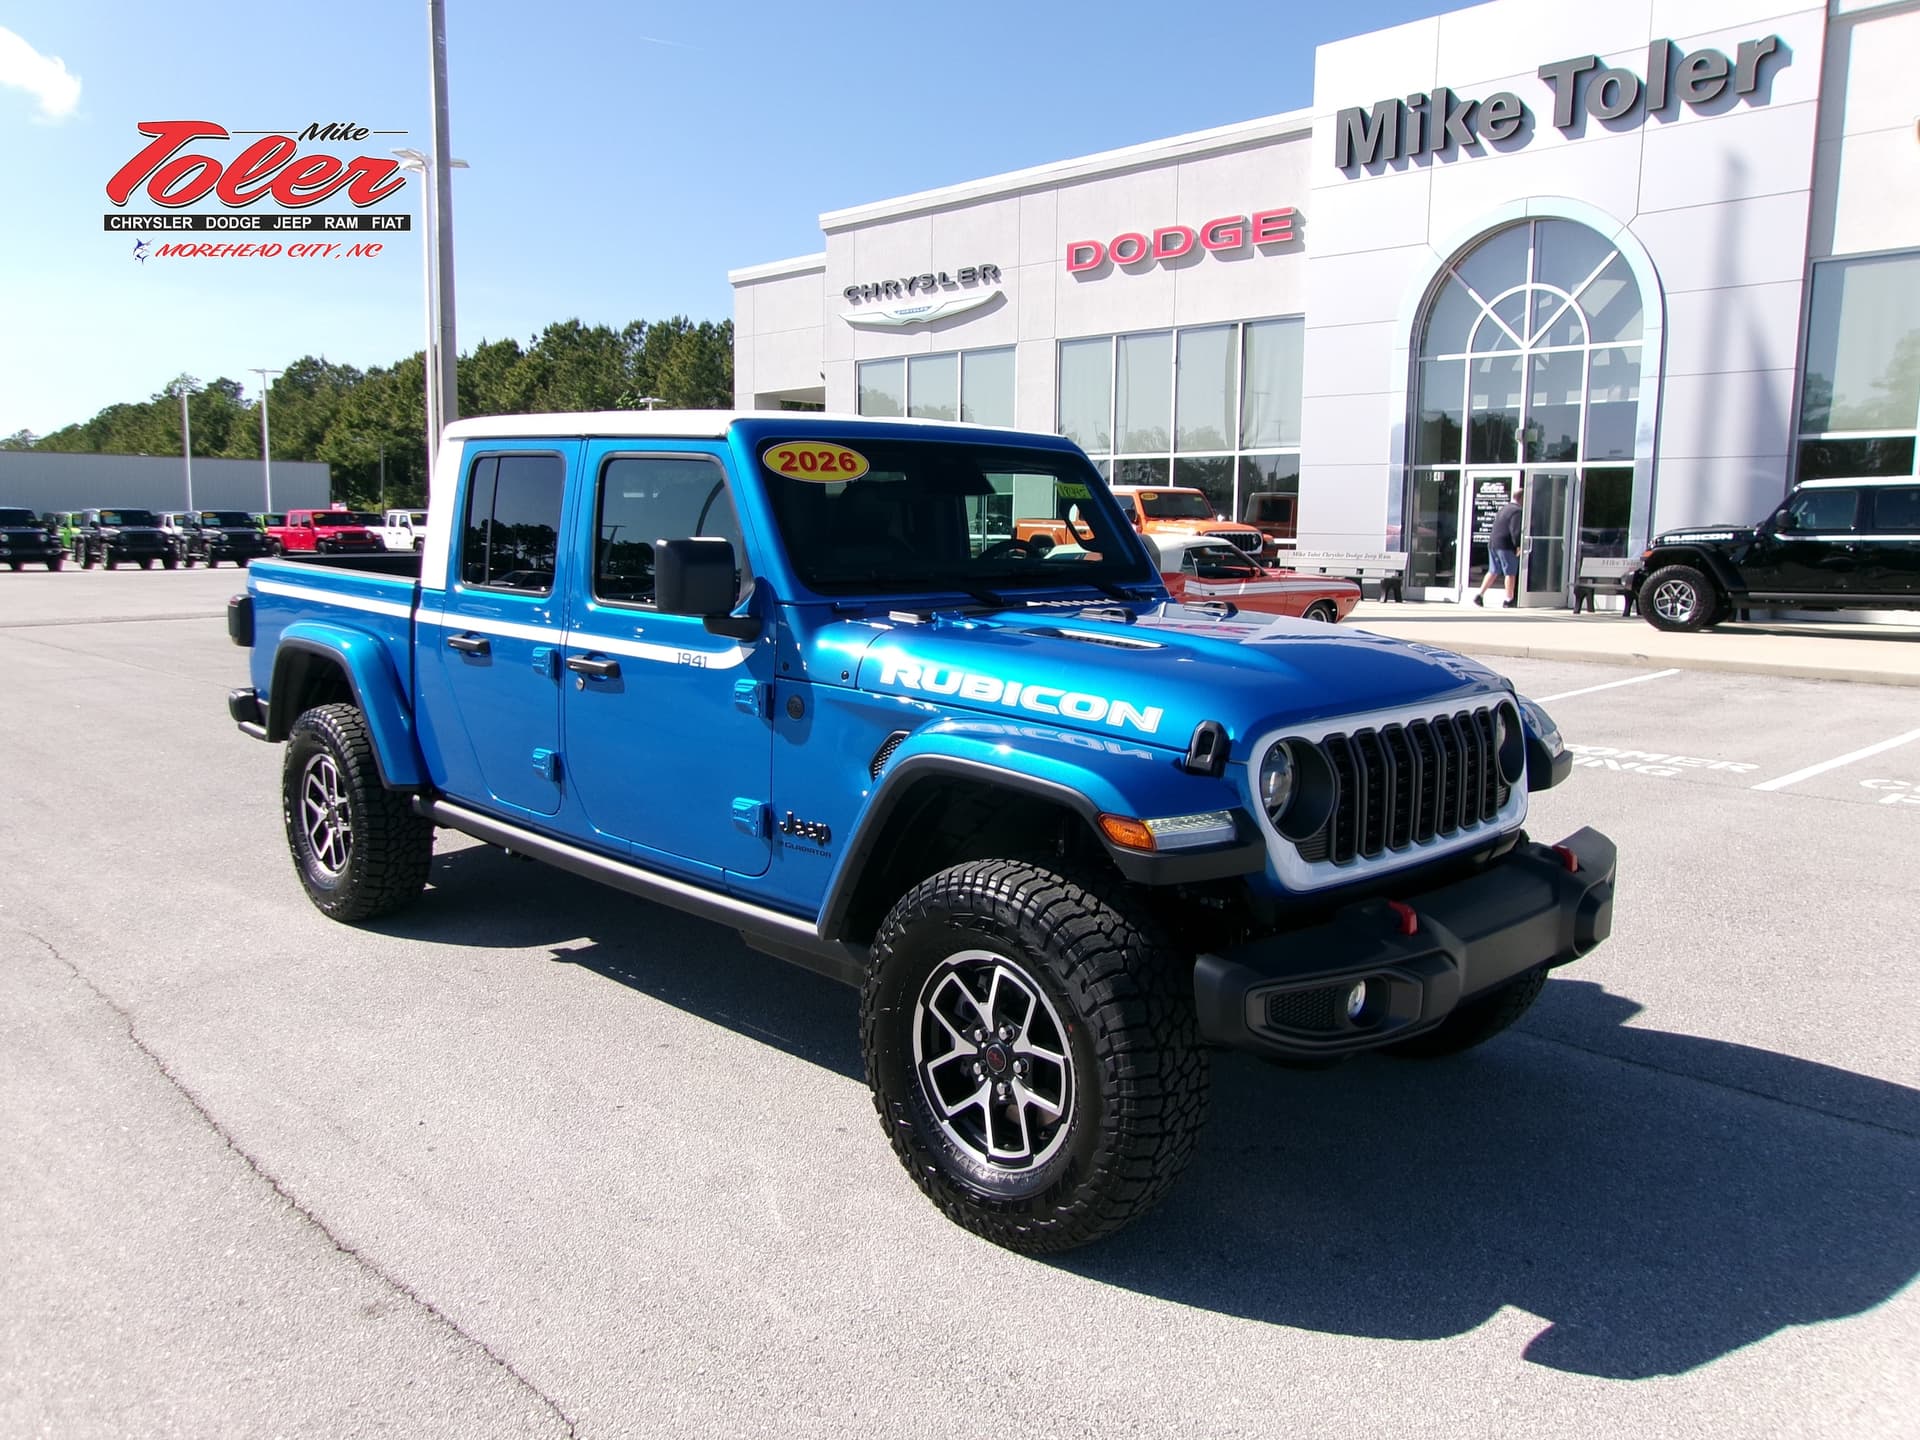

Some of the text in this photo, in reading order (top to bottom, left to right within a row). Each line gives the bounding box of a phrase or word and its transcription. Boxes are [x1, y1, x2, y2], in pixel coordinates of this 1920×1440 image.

[1335, 34, 1779, 169] Mike Toler
[1066, 207, 1296, 273] DODGE
[843, 263, 1001, 302] CHRYSLER
[777, 449, 859, 473] 2026
[677, 652, 707, 668] 1941
[880, 660, 1164, 733] RUBICON
[779, 810, 832, 848] Jeep
